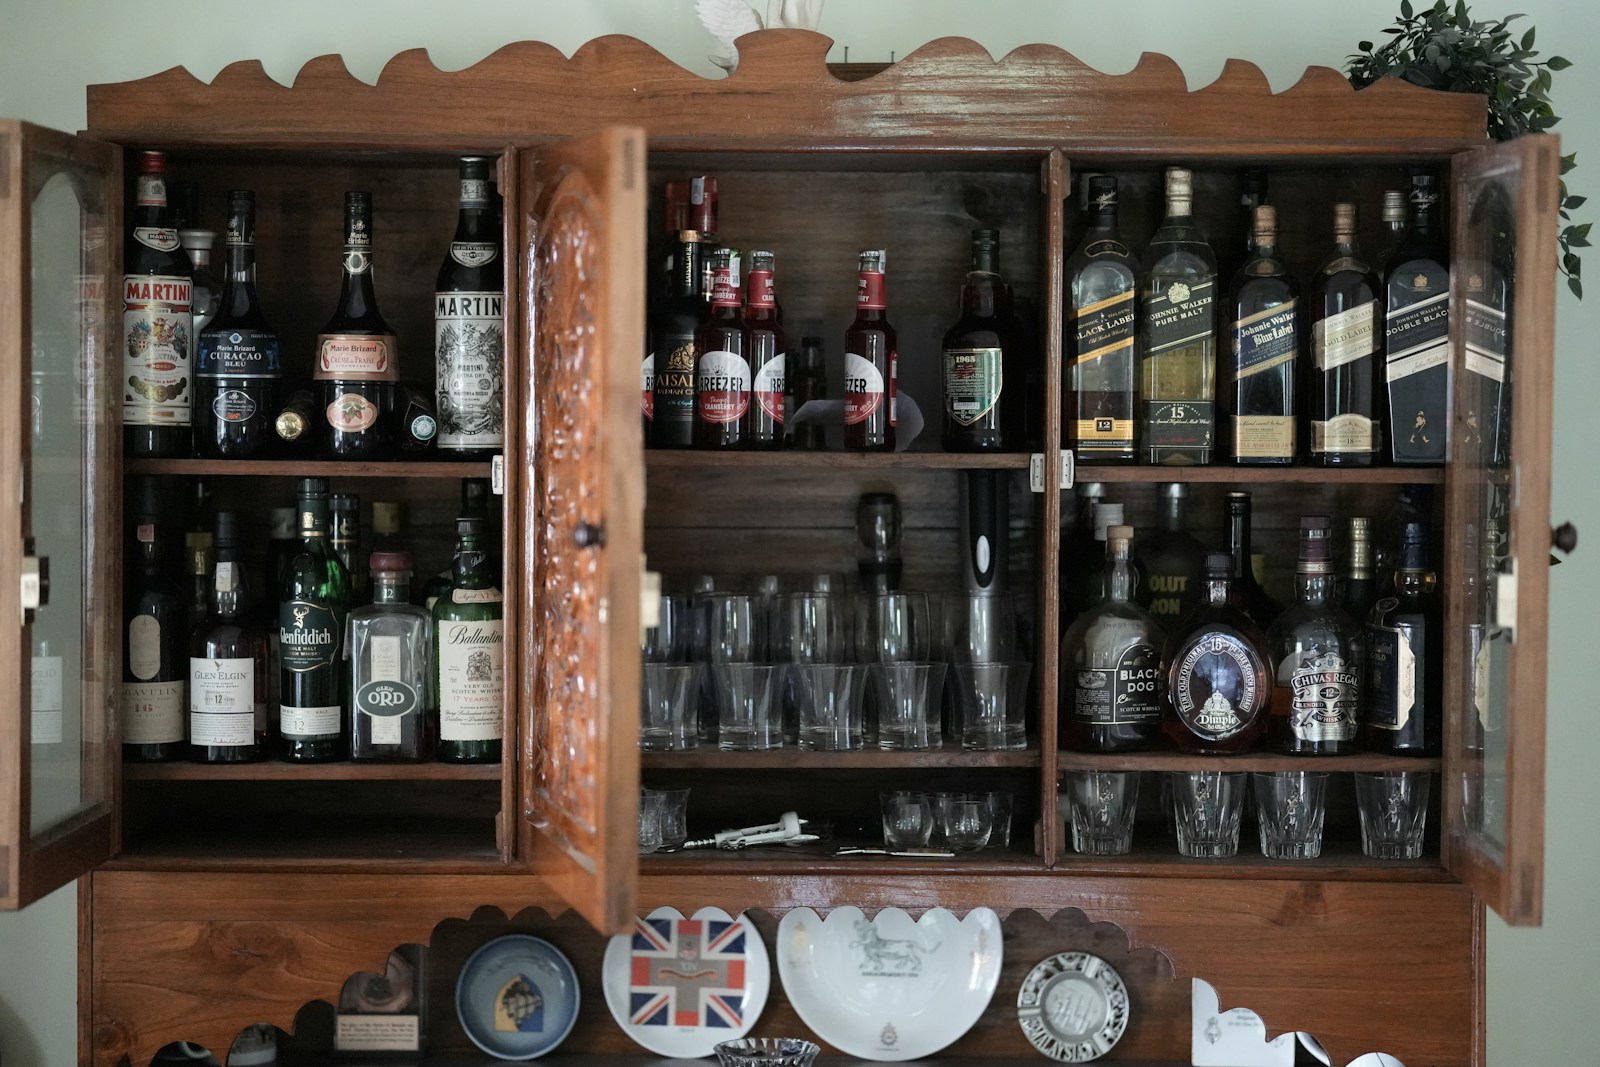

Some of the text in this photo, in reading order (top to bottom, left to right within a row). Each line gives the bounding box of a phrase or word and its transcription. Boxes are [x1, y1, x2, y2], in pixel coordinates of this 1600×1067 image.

[126, 283, 190, 301] MARTINI
[437, 297, 502, 317] MARTIN
[1149, 297, 1213, 321] OHNNIE WALKER
[1155, 307, 1204, 327] PURE MALT
[1396, 305, 1443, 325] JOHNNIE WALKER
[1241, 311, 1297, 338] Johnnie Walker
[1326, 318, 1348, 329] OHNNIE
[1386, 319, 1421, 337] DOUBLE
[1423, 309, 1449, 323] BLAC
[1252, 331, 1274, 348] Blue
[1271, 323, 1294, 342] Label
[1323, 334, 1348, 348] GOLD
[210, 352, 262, 362] CURAÇAO
[1170, 407, 1185, 419] 15
[384, 588, 393, 599] 12
[448, 625, 502, 645] Ballantin
[1210, 638, 1222, 651] 15
[195, 670, 247, 680] GLEN ELGIN
[1294, 673, 1358, 688] CHIVAS REGAL
[1128, 682, 1154, 692] DOG
[1325, 688, 1335, 697] 12
[215, 695, 223, 704] 12
[367, 691, 405, 706] ORD
[294, 720, 305, 731] 12
[1199, 714, 1236, 726] Dimple
[1317, 715, 1342, 723] WHISKY
